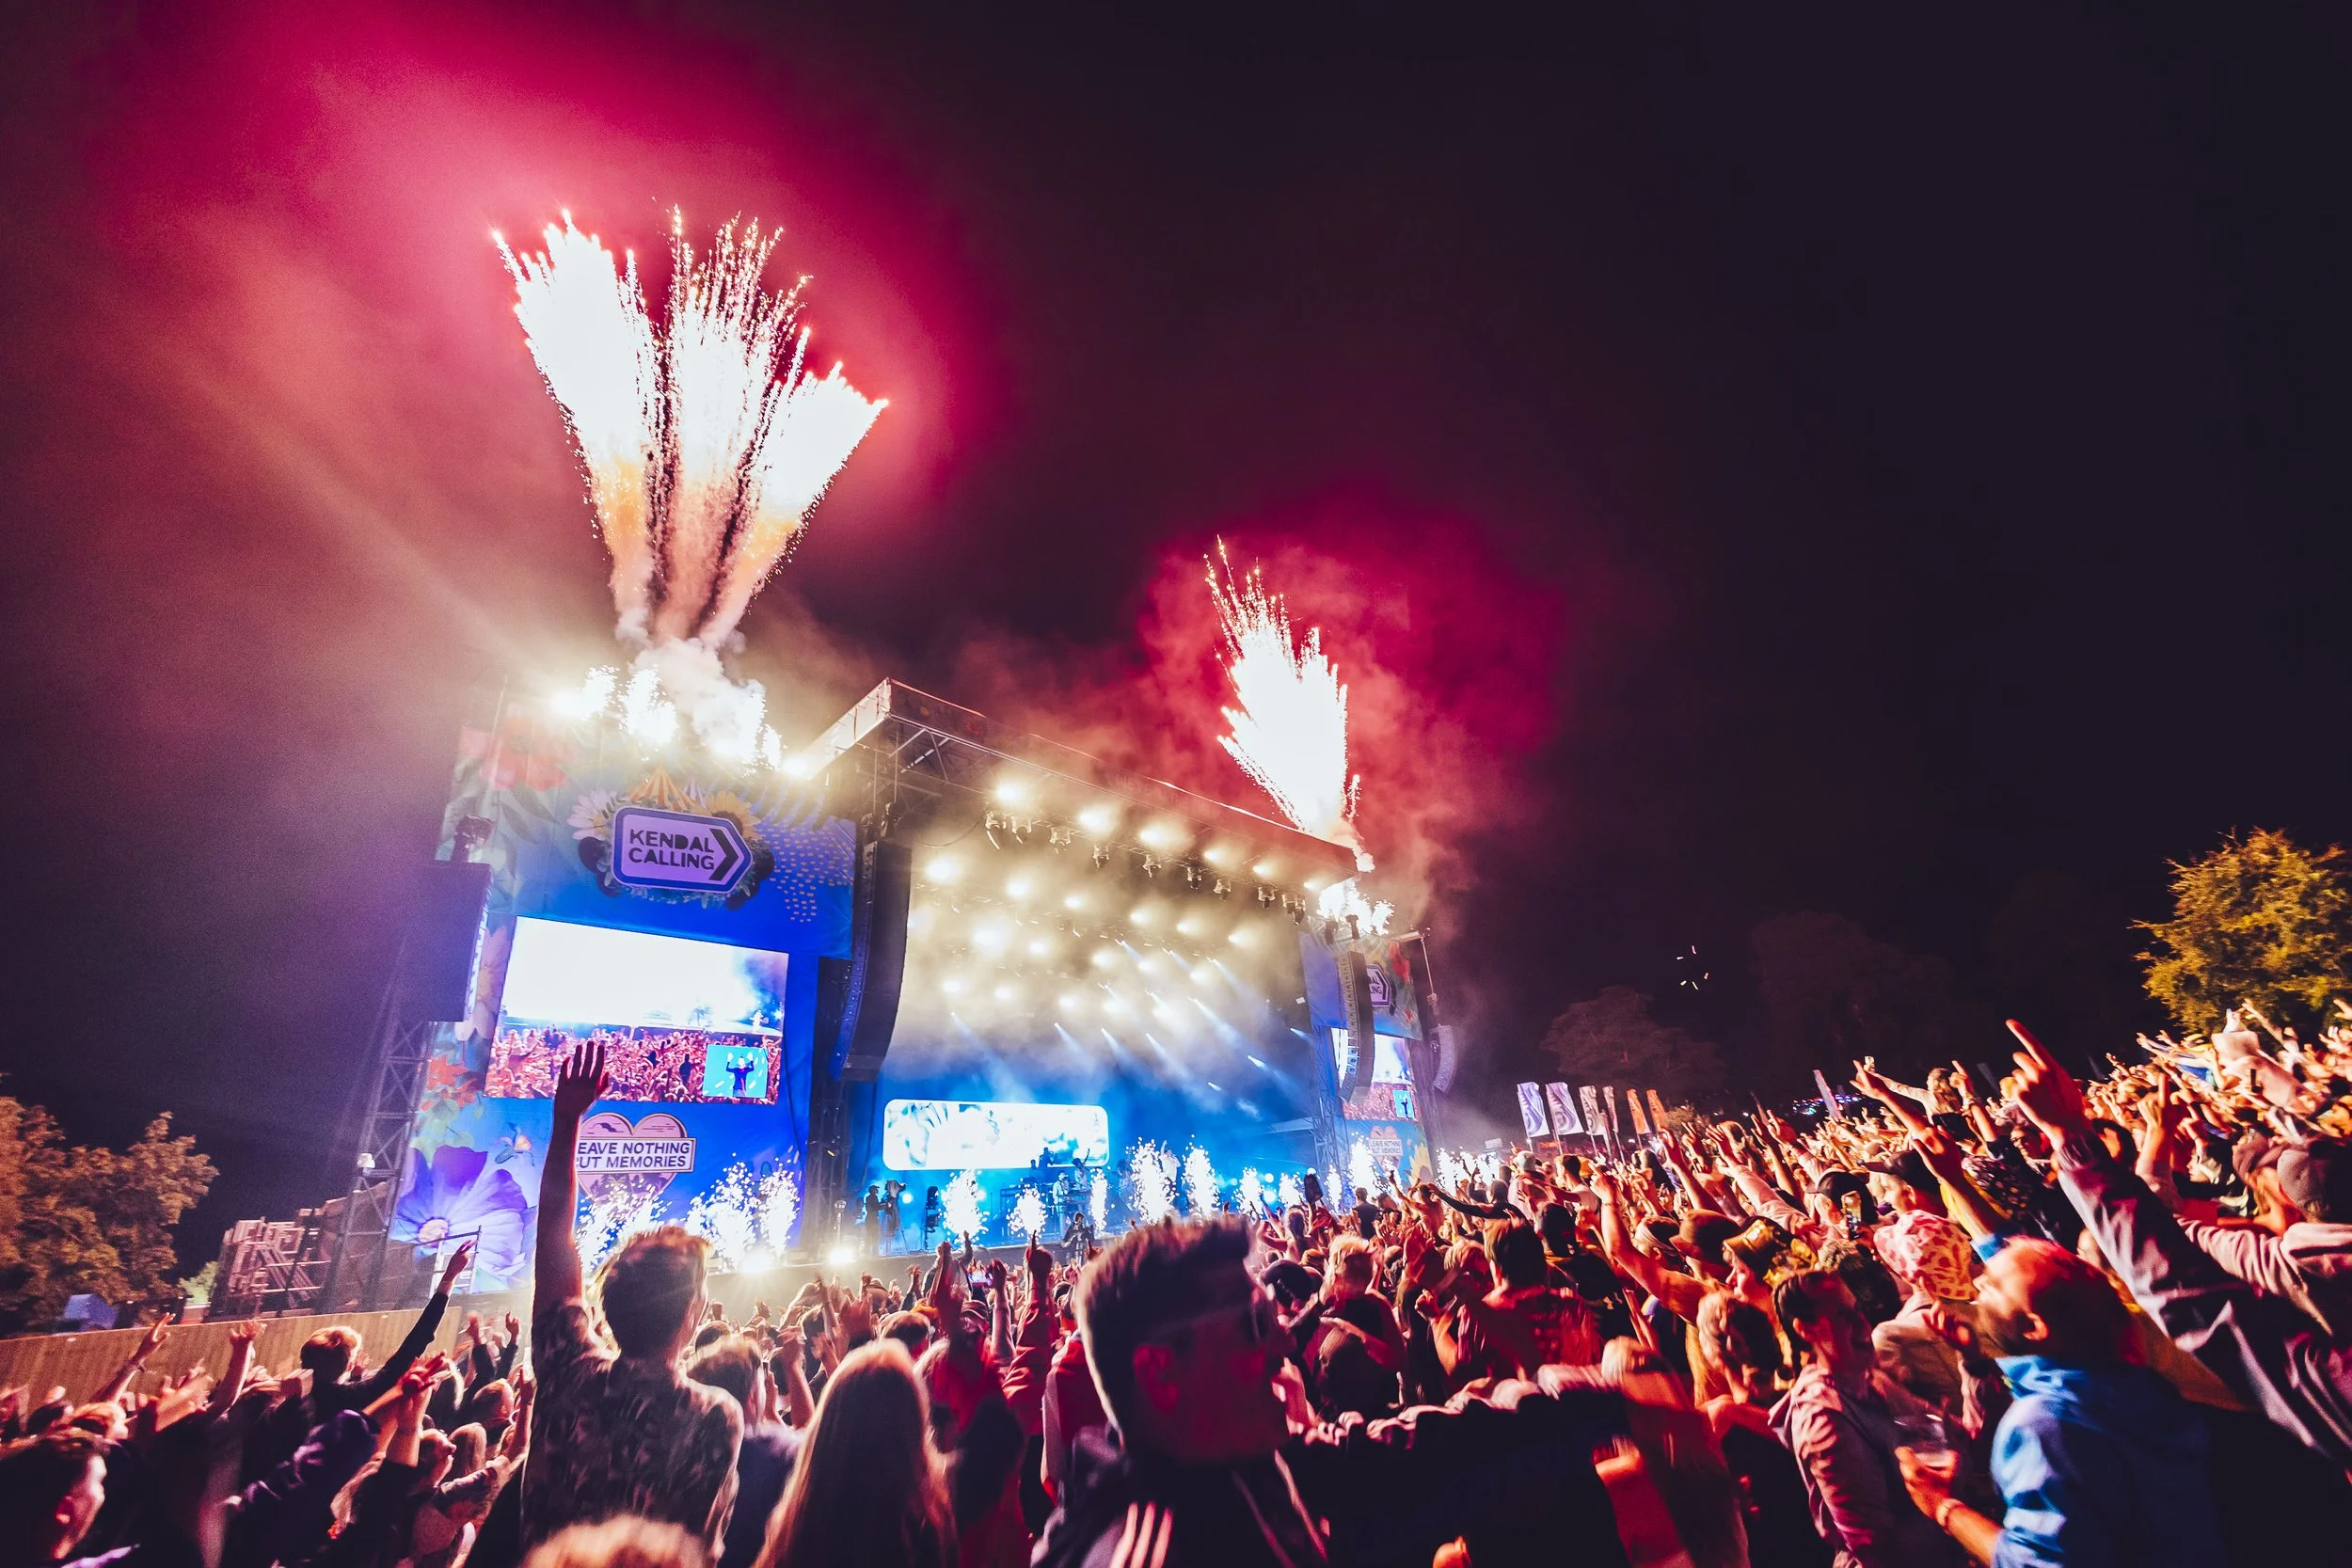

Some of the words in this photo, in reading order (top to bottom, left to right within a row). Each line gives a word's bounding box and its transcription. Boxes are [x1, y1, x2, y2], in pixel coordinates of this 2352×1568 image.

[629, 829, 714, 853] KENDAL
[628, 847, 714, 870] CALLING
[578, 1142, 617, 1154] EAVE
[623, 1143, 690, 1154] NOTHING
[606, 1156, 686, 1168] MEMORIES
